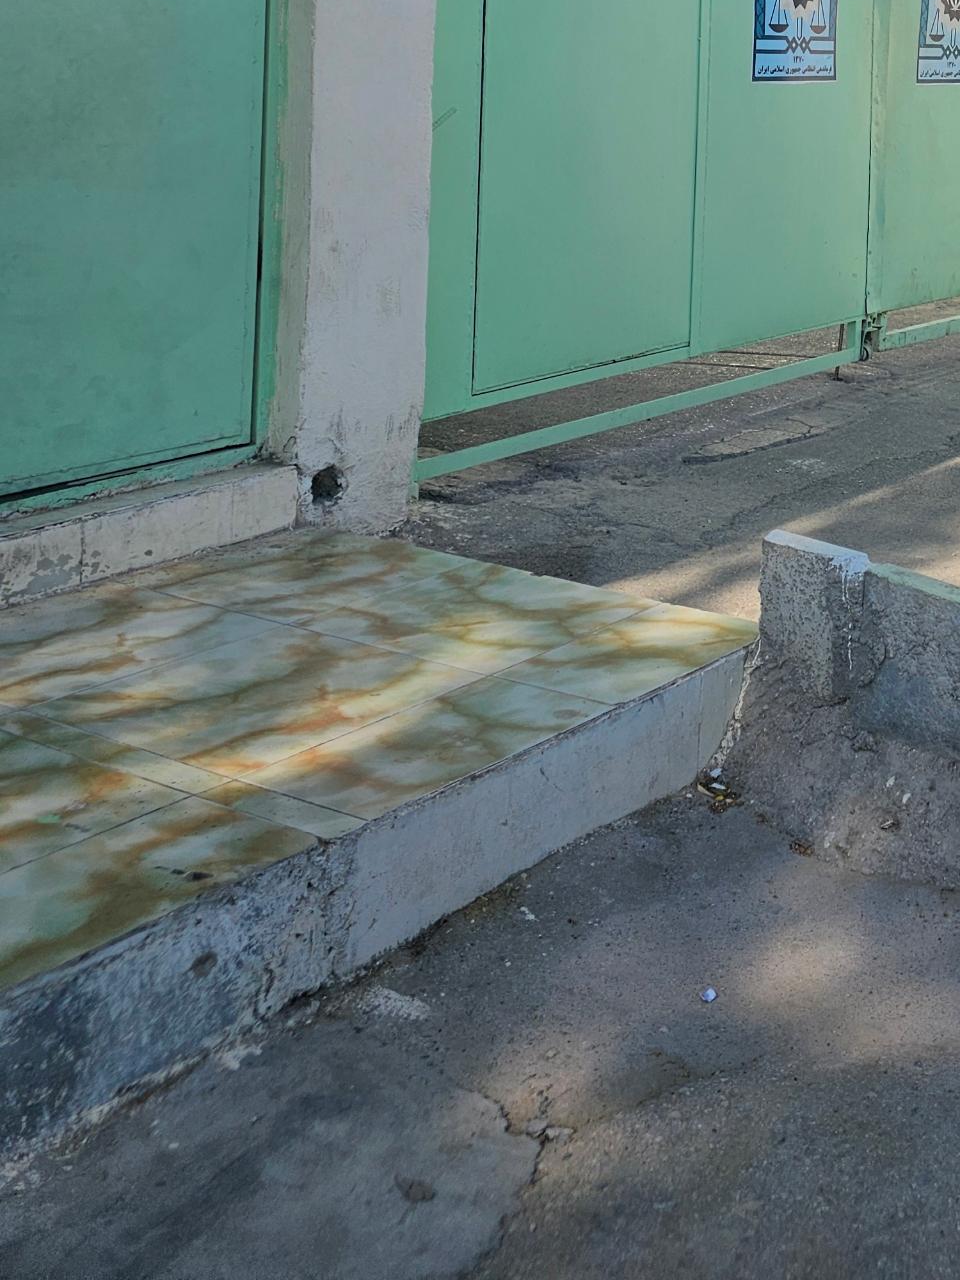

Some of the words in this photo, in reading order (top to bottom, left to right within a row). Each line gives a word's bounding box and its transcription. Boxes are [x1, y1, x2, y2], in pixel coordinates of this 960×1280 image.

[793, 55, 805, 64] ۱۳۷۰
[757, 65, 770, 75] ایران
[769, 64, 785, 75] اسلامی
